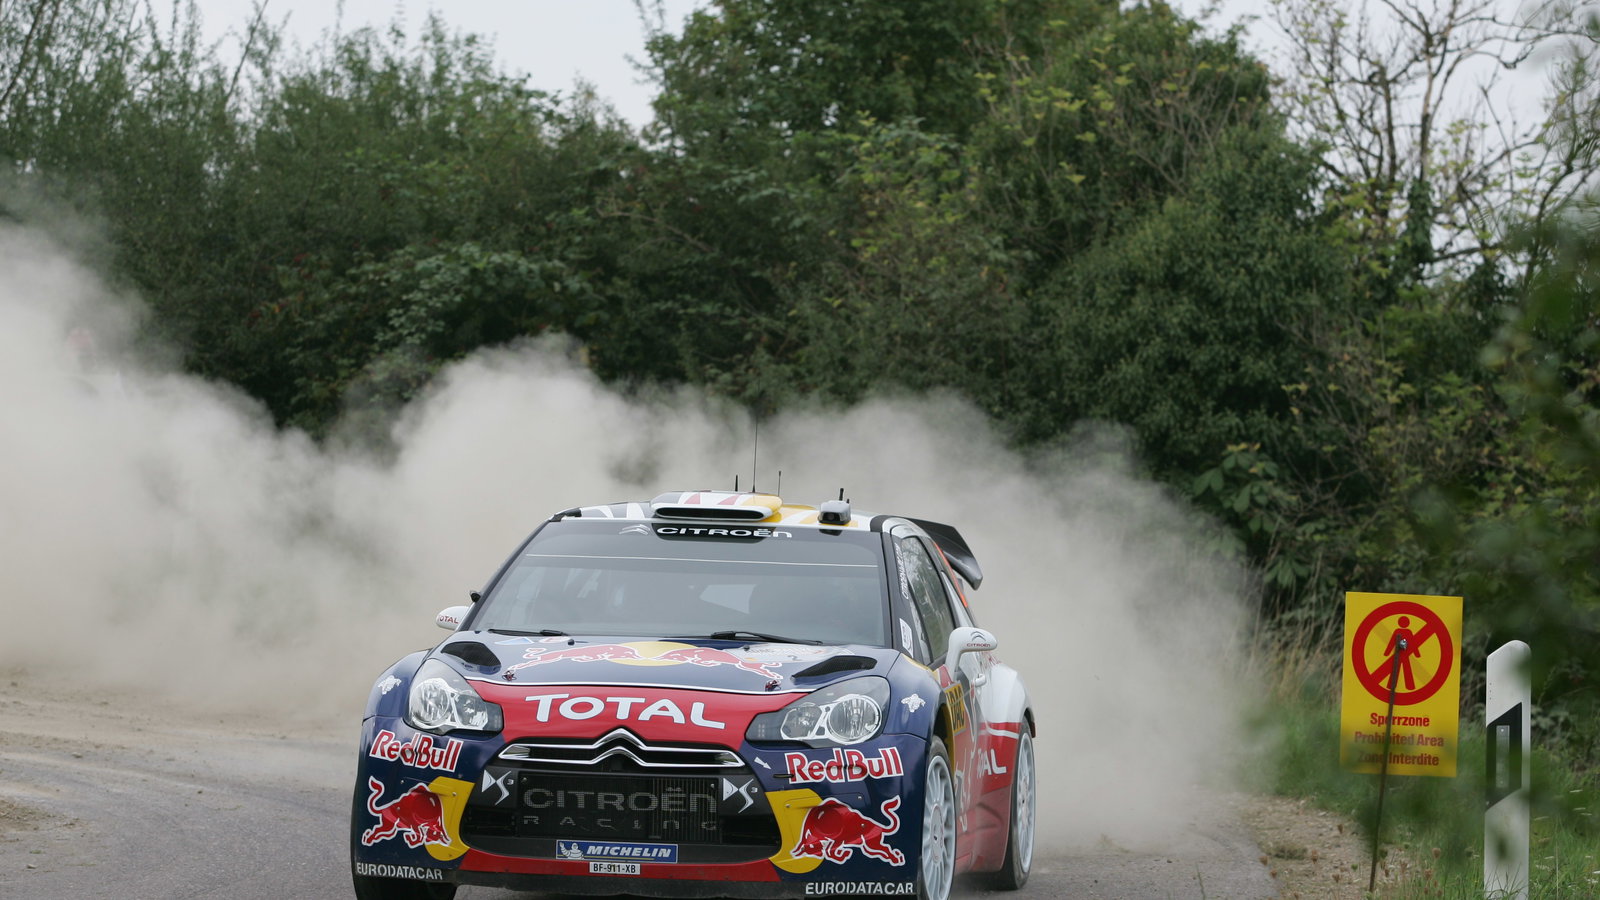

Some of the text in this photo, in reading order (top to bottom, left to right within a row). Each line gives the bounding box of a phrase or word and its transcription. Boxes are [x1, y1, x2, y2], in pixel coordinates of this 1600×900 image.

[525, 693, 726, 730] TOTAL
[1369, 712, 1430, 727] Sprrzone
[1354, 731, 1445, 747] Prohiited Area
[1389, 752, 1439, 766] Interdite
[586, 845, 672, 858] MICHELIN
[356, 862, 443, 880] EURODATACAR
[593, 863, 636, 874] BF-911-XB
[805, 881, 914, 895] EURODATACAR
